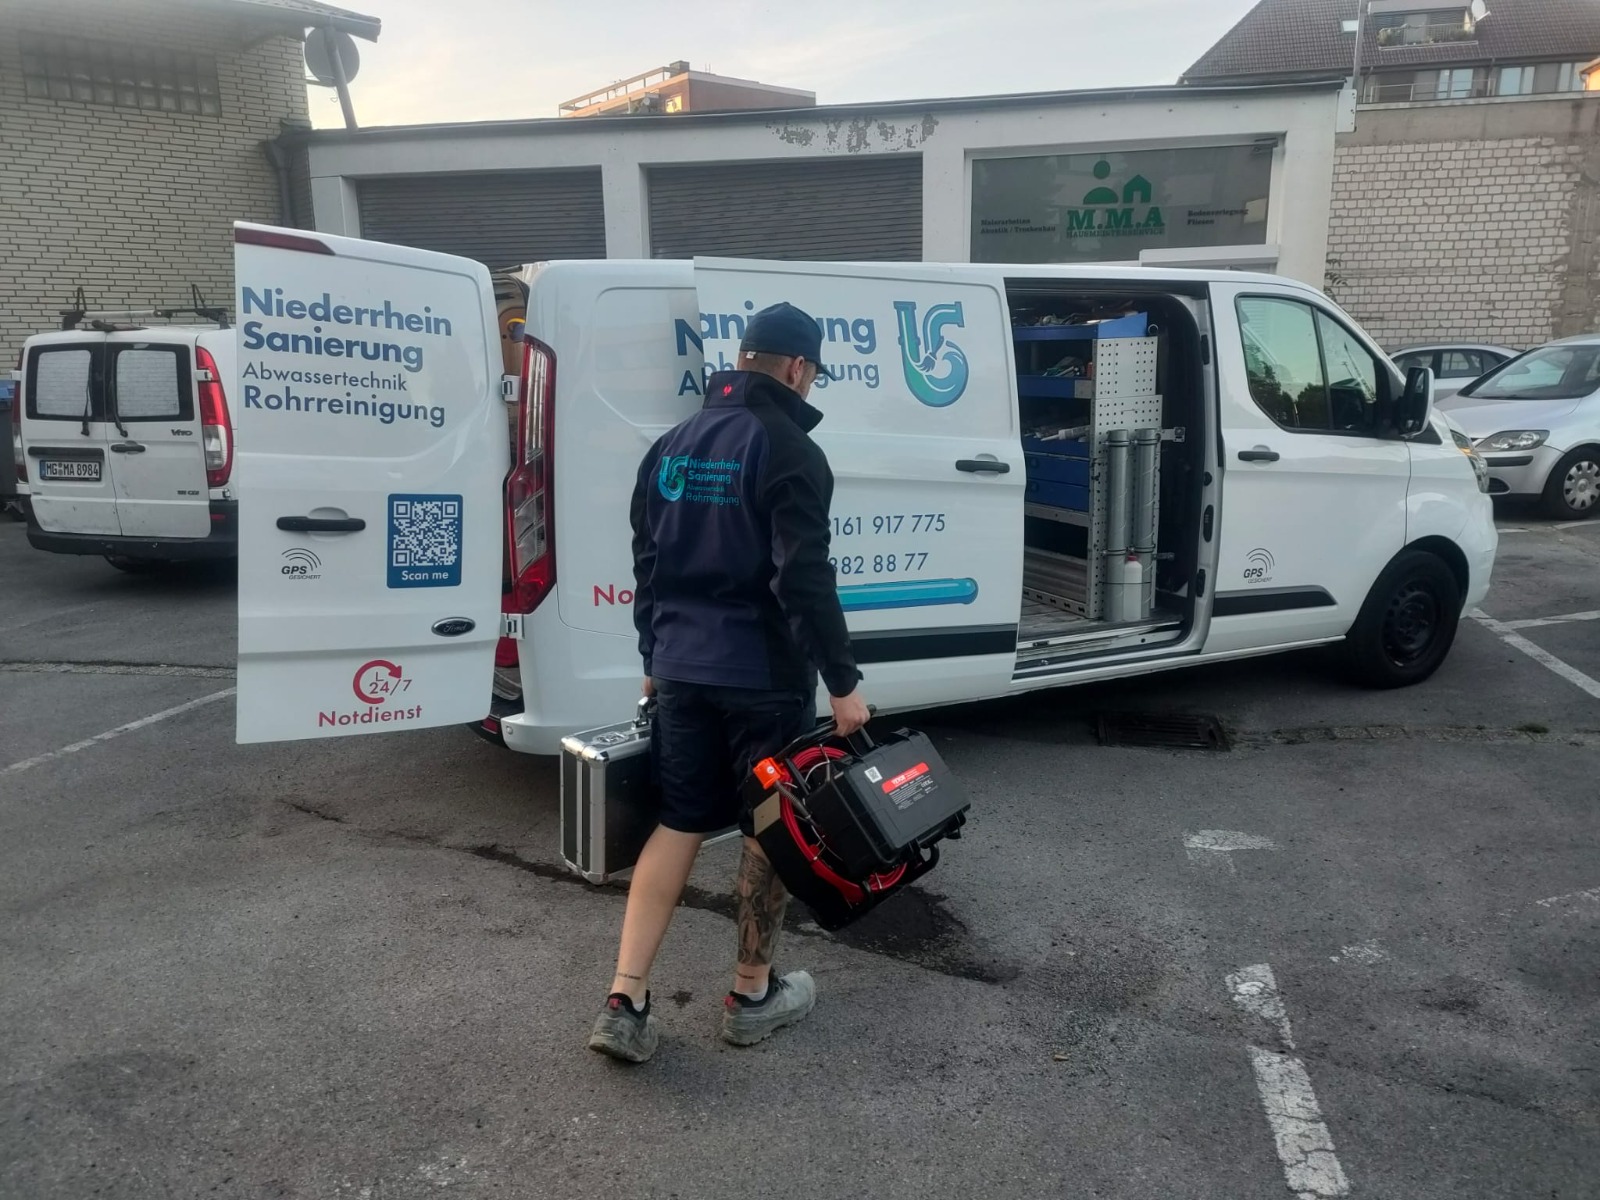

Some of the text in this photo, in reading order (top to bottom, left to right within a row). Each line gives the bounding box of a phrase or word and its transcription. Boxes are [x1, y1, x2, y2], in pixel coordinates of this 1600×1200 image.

[242, 286, 452, 336] Niederrhein
[243, 321, 424, 373] Sanierung
[242, 361, 408, 391] Abwassertechnik
[244, 385, 445, 428] Rohrreinigung
[76, 463, 99, 477] 8984
[687, 470, 732, 484] Sanierung
[872, 515, 905, 534] 917
[912, 514, 946, 533] 775
[281, 565, 308, 575] GPS
[873, 553, 897, 573] 88
[904, 552, 929, 571] 77
[1243, 567, 1264, 578] GPS
[401, 570, 449, 581] Scan me
[369, 678, 413, 696] 24/7
[318, 704, 422, 728] Notdienst
